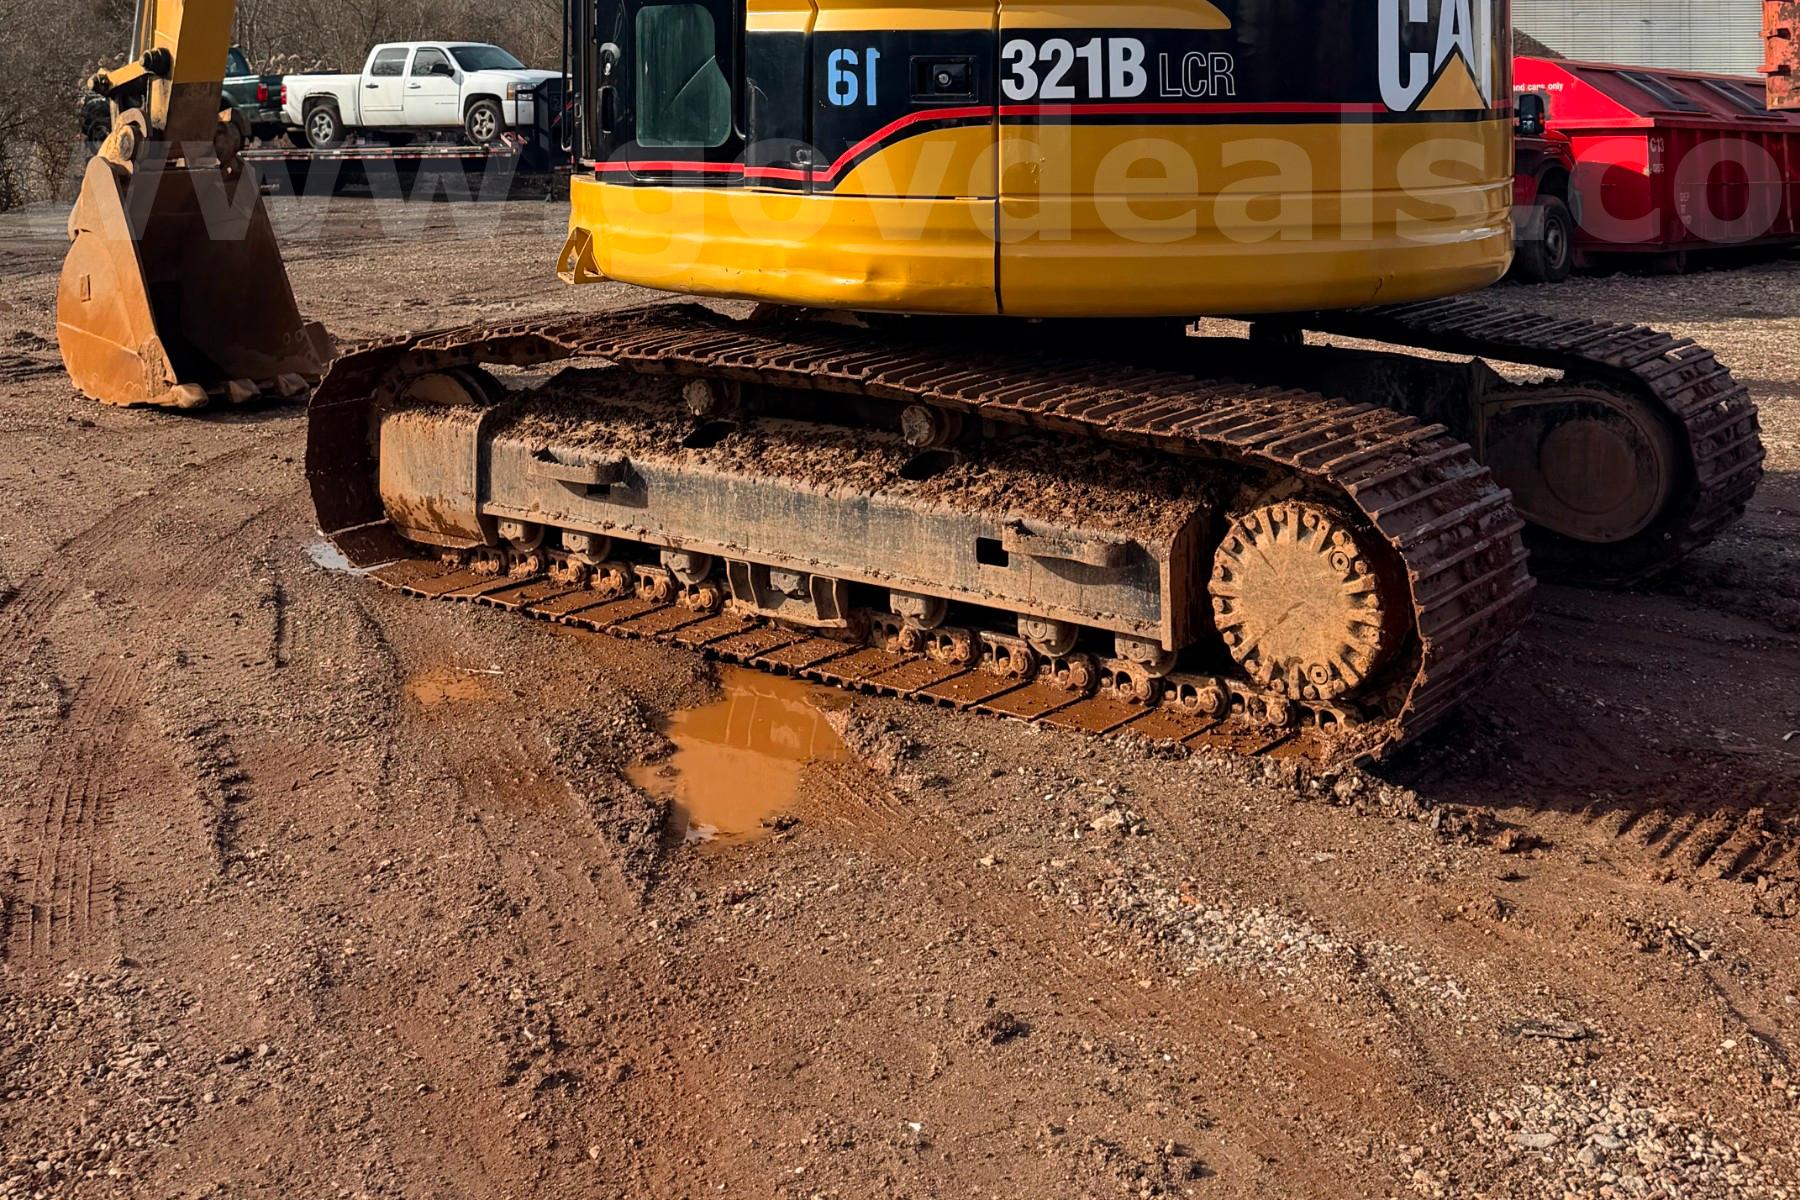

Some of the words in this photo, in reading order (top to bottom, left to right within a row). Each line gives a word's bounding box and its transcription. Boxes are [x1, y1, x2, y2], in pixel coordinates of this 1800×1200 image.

[1001, 37, 1147, 99] 321B
[1159, 52, 1236, 96] LCR
[1547, 81, 1564, 93] only
